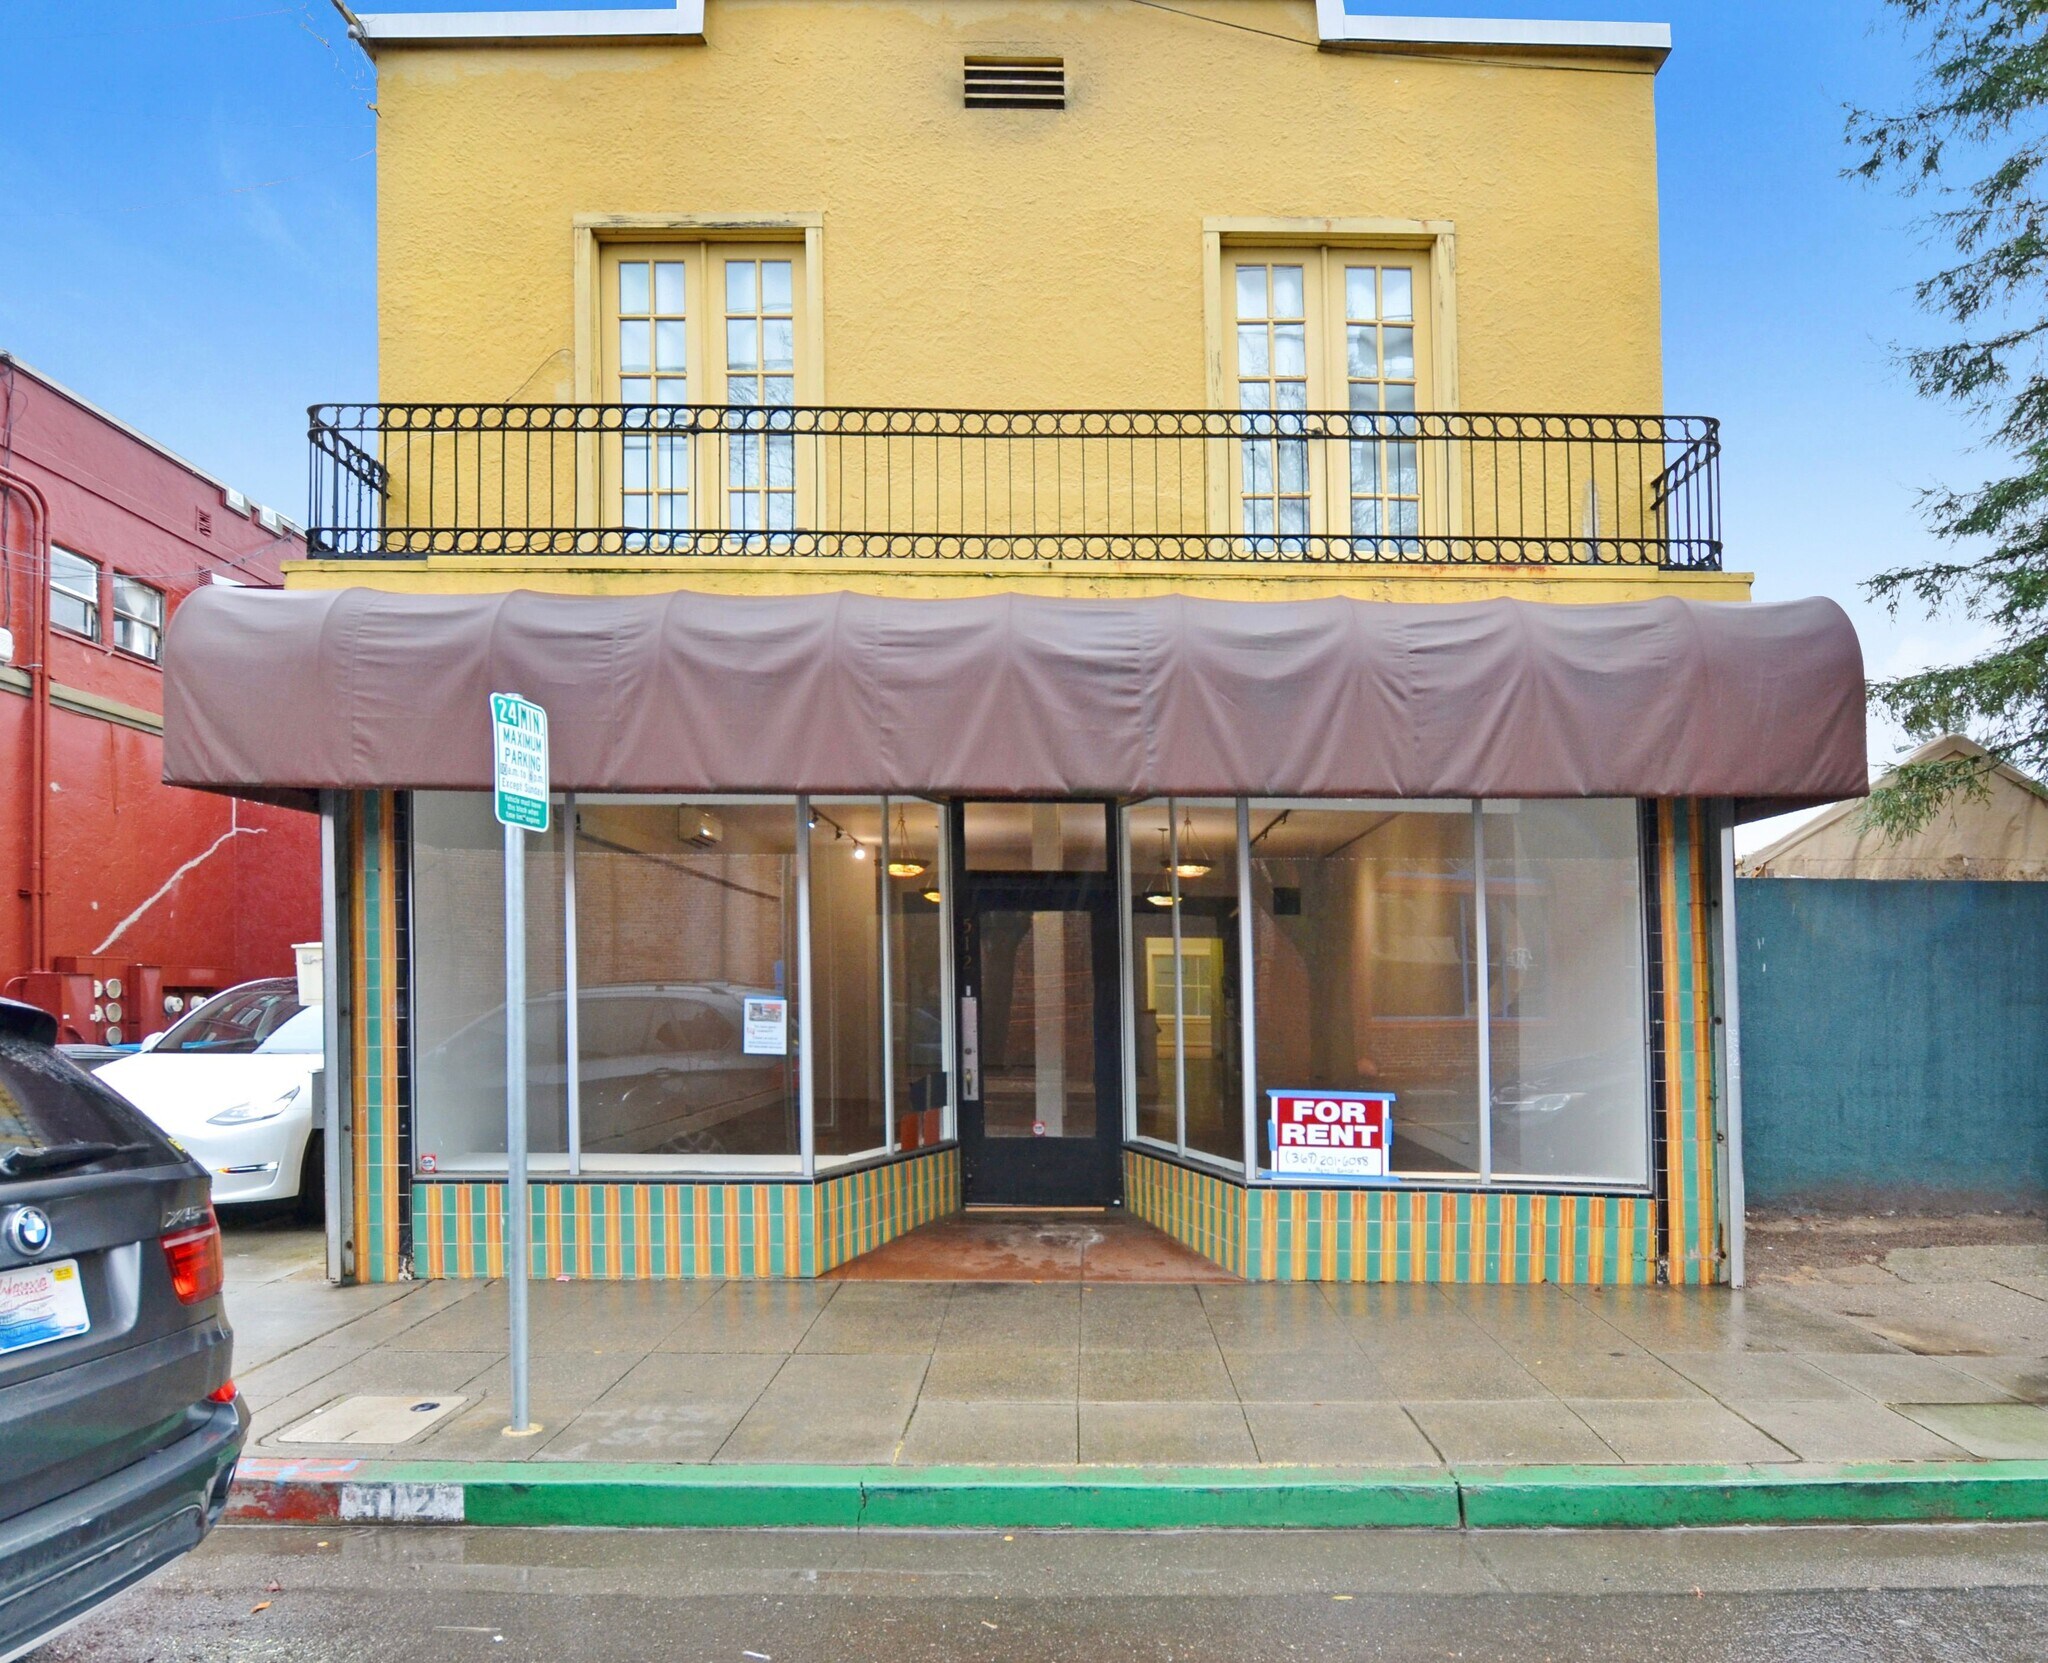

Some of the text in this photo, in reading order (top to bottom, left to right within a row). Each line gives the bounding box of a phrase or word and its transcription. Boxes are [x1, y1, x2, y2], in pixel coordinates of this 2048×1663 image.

[498, 699, 544, 736] 24 MIN.
[503, 726, 542, 754] MAXIMUM
[505, 747, 541, 772] PARKING
[502, 777, 544, 798] Except Sunday
[1293, 1100, 1366, 1123] FOR
[1281, 1122, 1379, 1147] RENT
